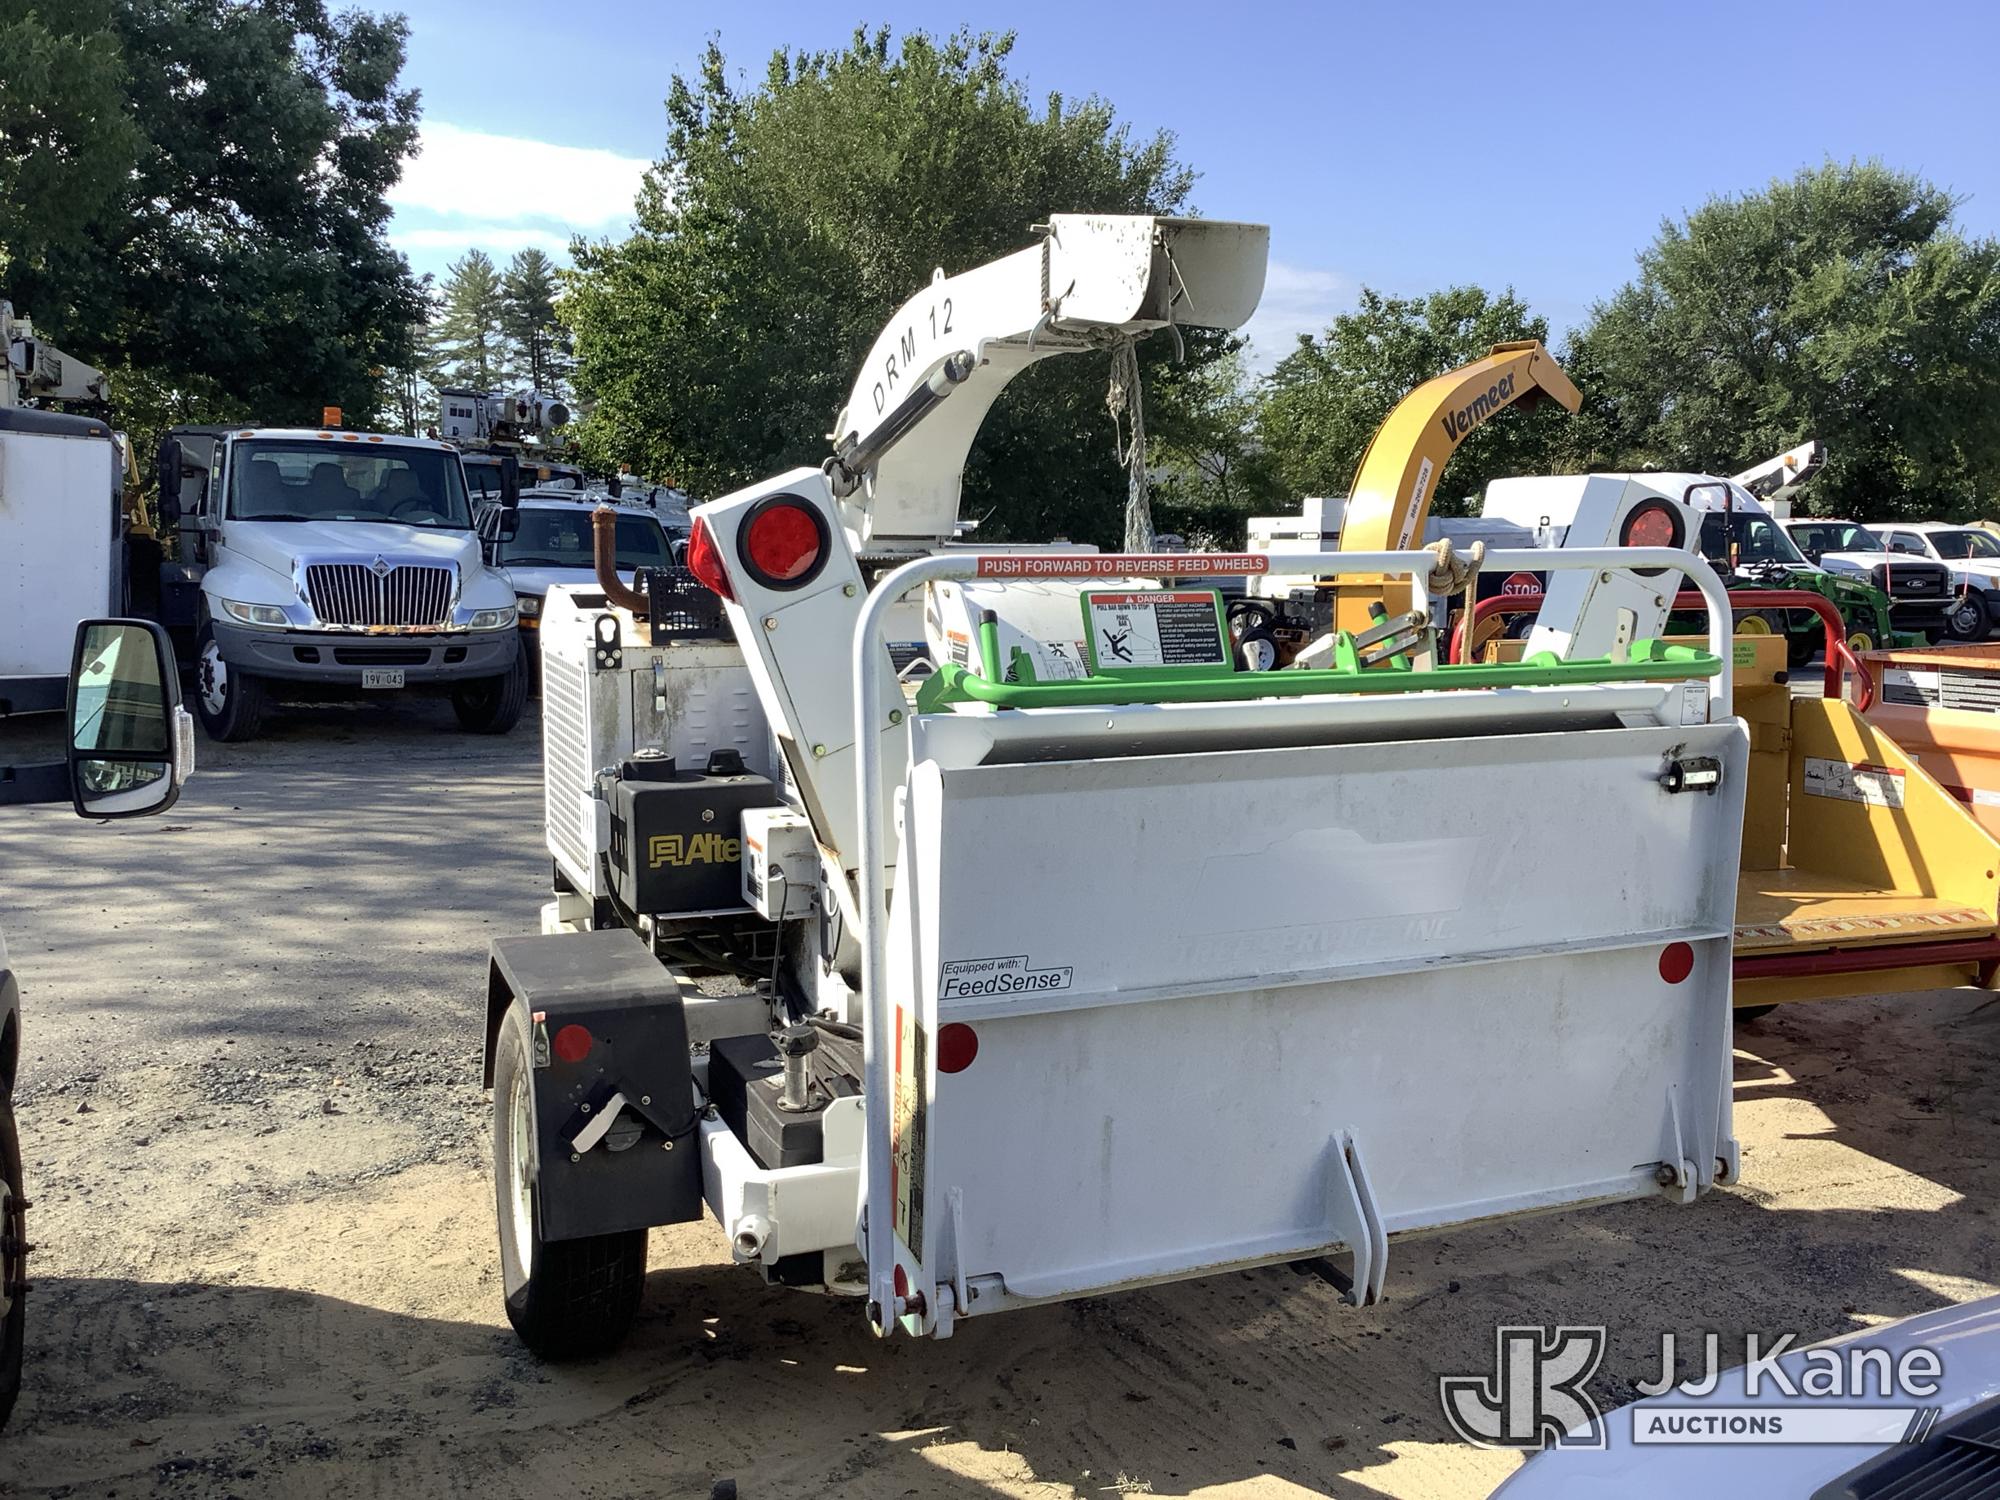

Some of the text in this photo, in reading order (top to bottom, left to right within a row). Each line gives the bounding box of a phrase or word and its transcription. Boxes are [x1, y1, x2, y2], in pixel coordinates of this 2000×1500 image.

[873, 297, 953, 416] DRM 12
[1441, 371, 1515, 443] Vermeer
[984, 558, 1264, 573] PUSH FORWARD TO REVERSE FEED WHEELS
[1504, 584, 1540, 596] STOP
[1137, 595, 1175, 603] DANGER
[684, 832, 741, 864] Alte
[945, 959, 1021, 976] Equipped with:
